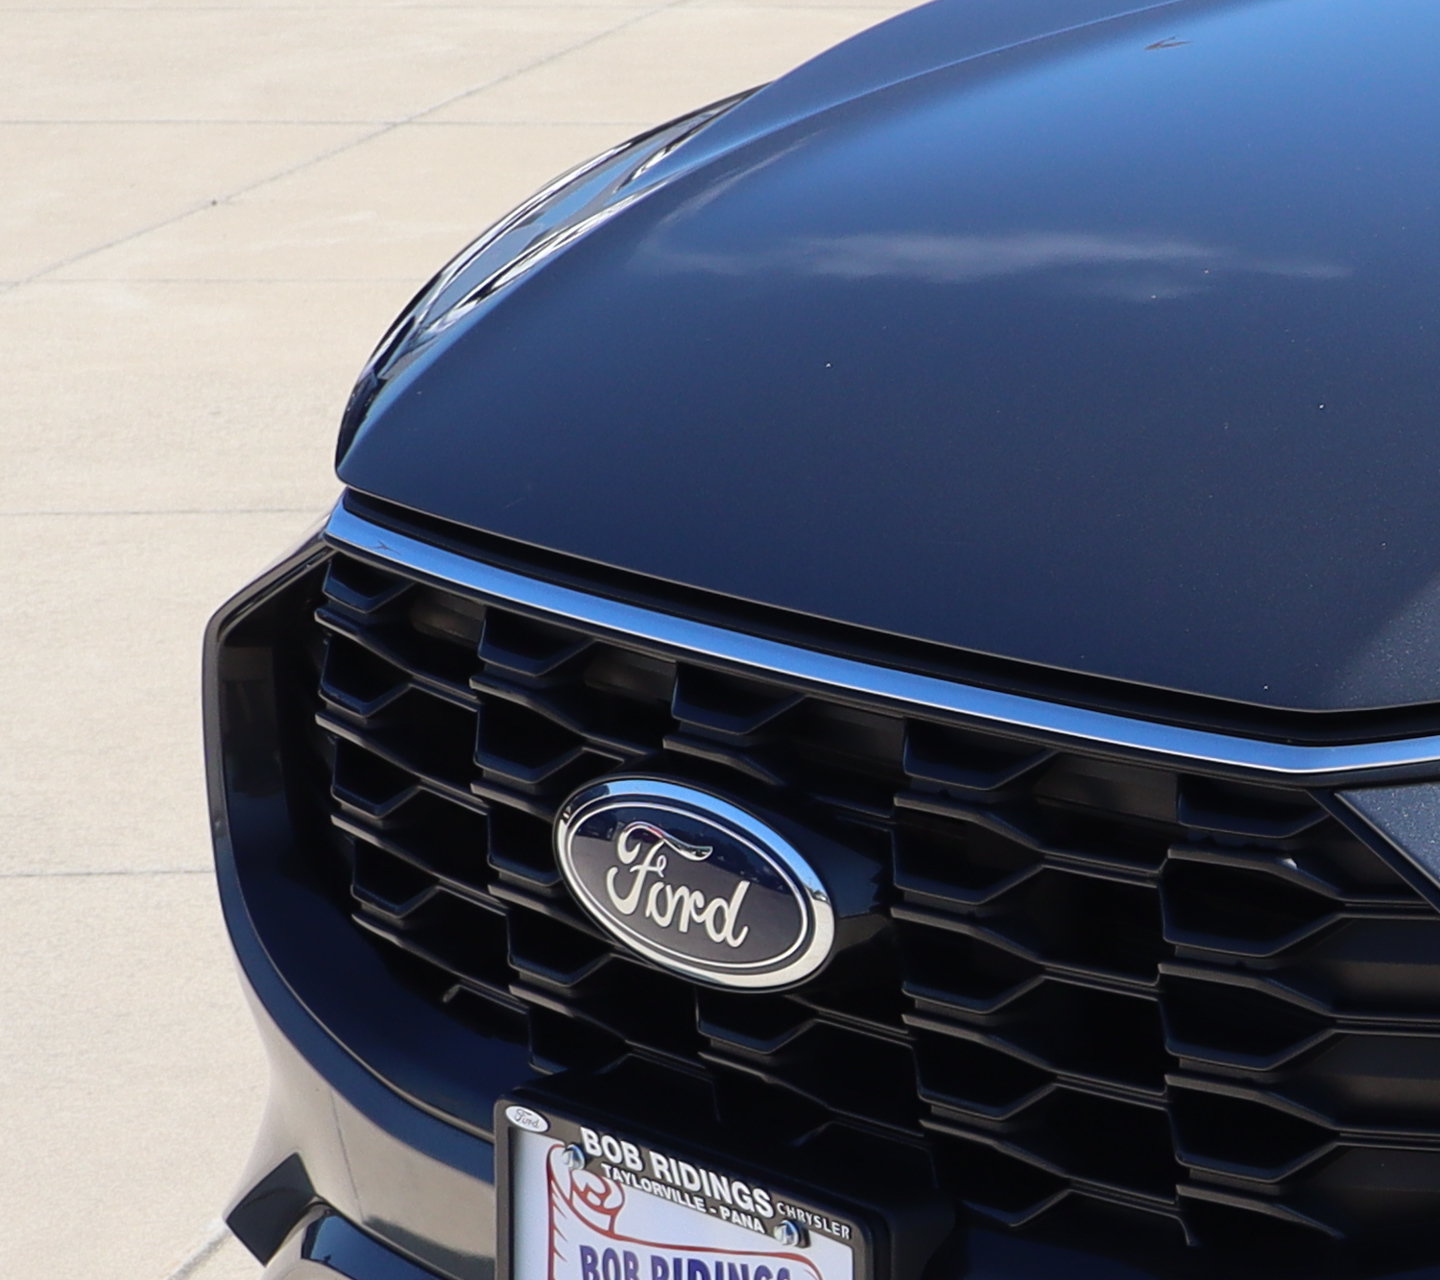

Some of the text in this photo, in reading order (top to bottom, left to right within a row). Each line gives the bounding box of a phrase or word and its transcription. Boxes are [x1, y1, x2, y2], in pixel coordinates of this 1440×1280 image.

[606, 821, 714, 948] Ford
[514, 1108, 542, 1129] Ford
[579, 1126, 852, 1241] BOB RIDINGS CHRYSLER
[601, 1162, 707, 1213] TAYLORVILLE
[720, 1207, 766, 1235] PANA
